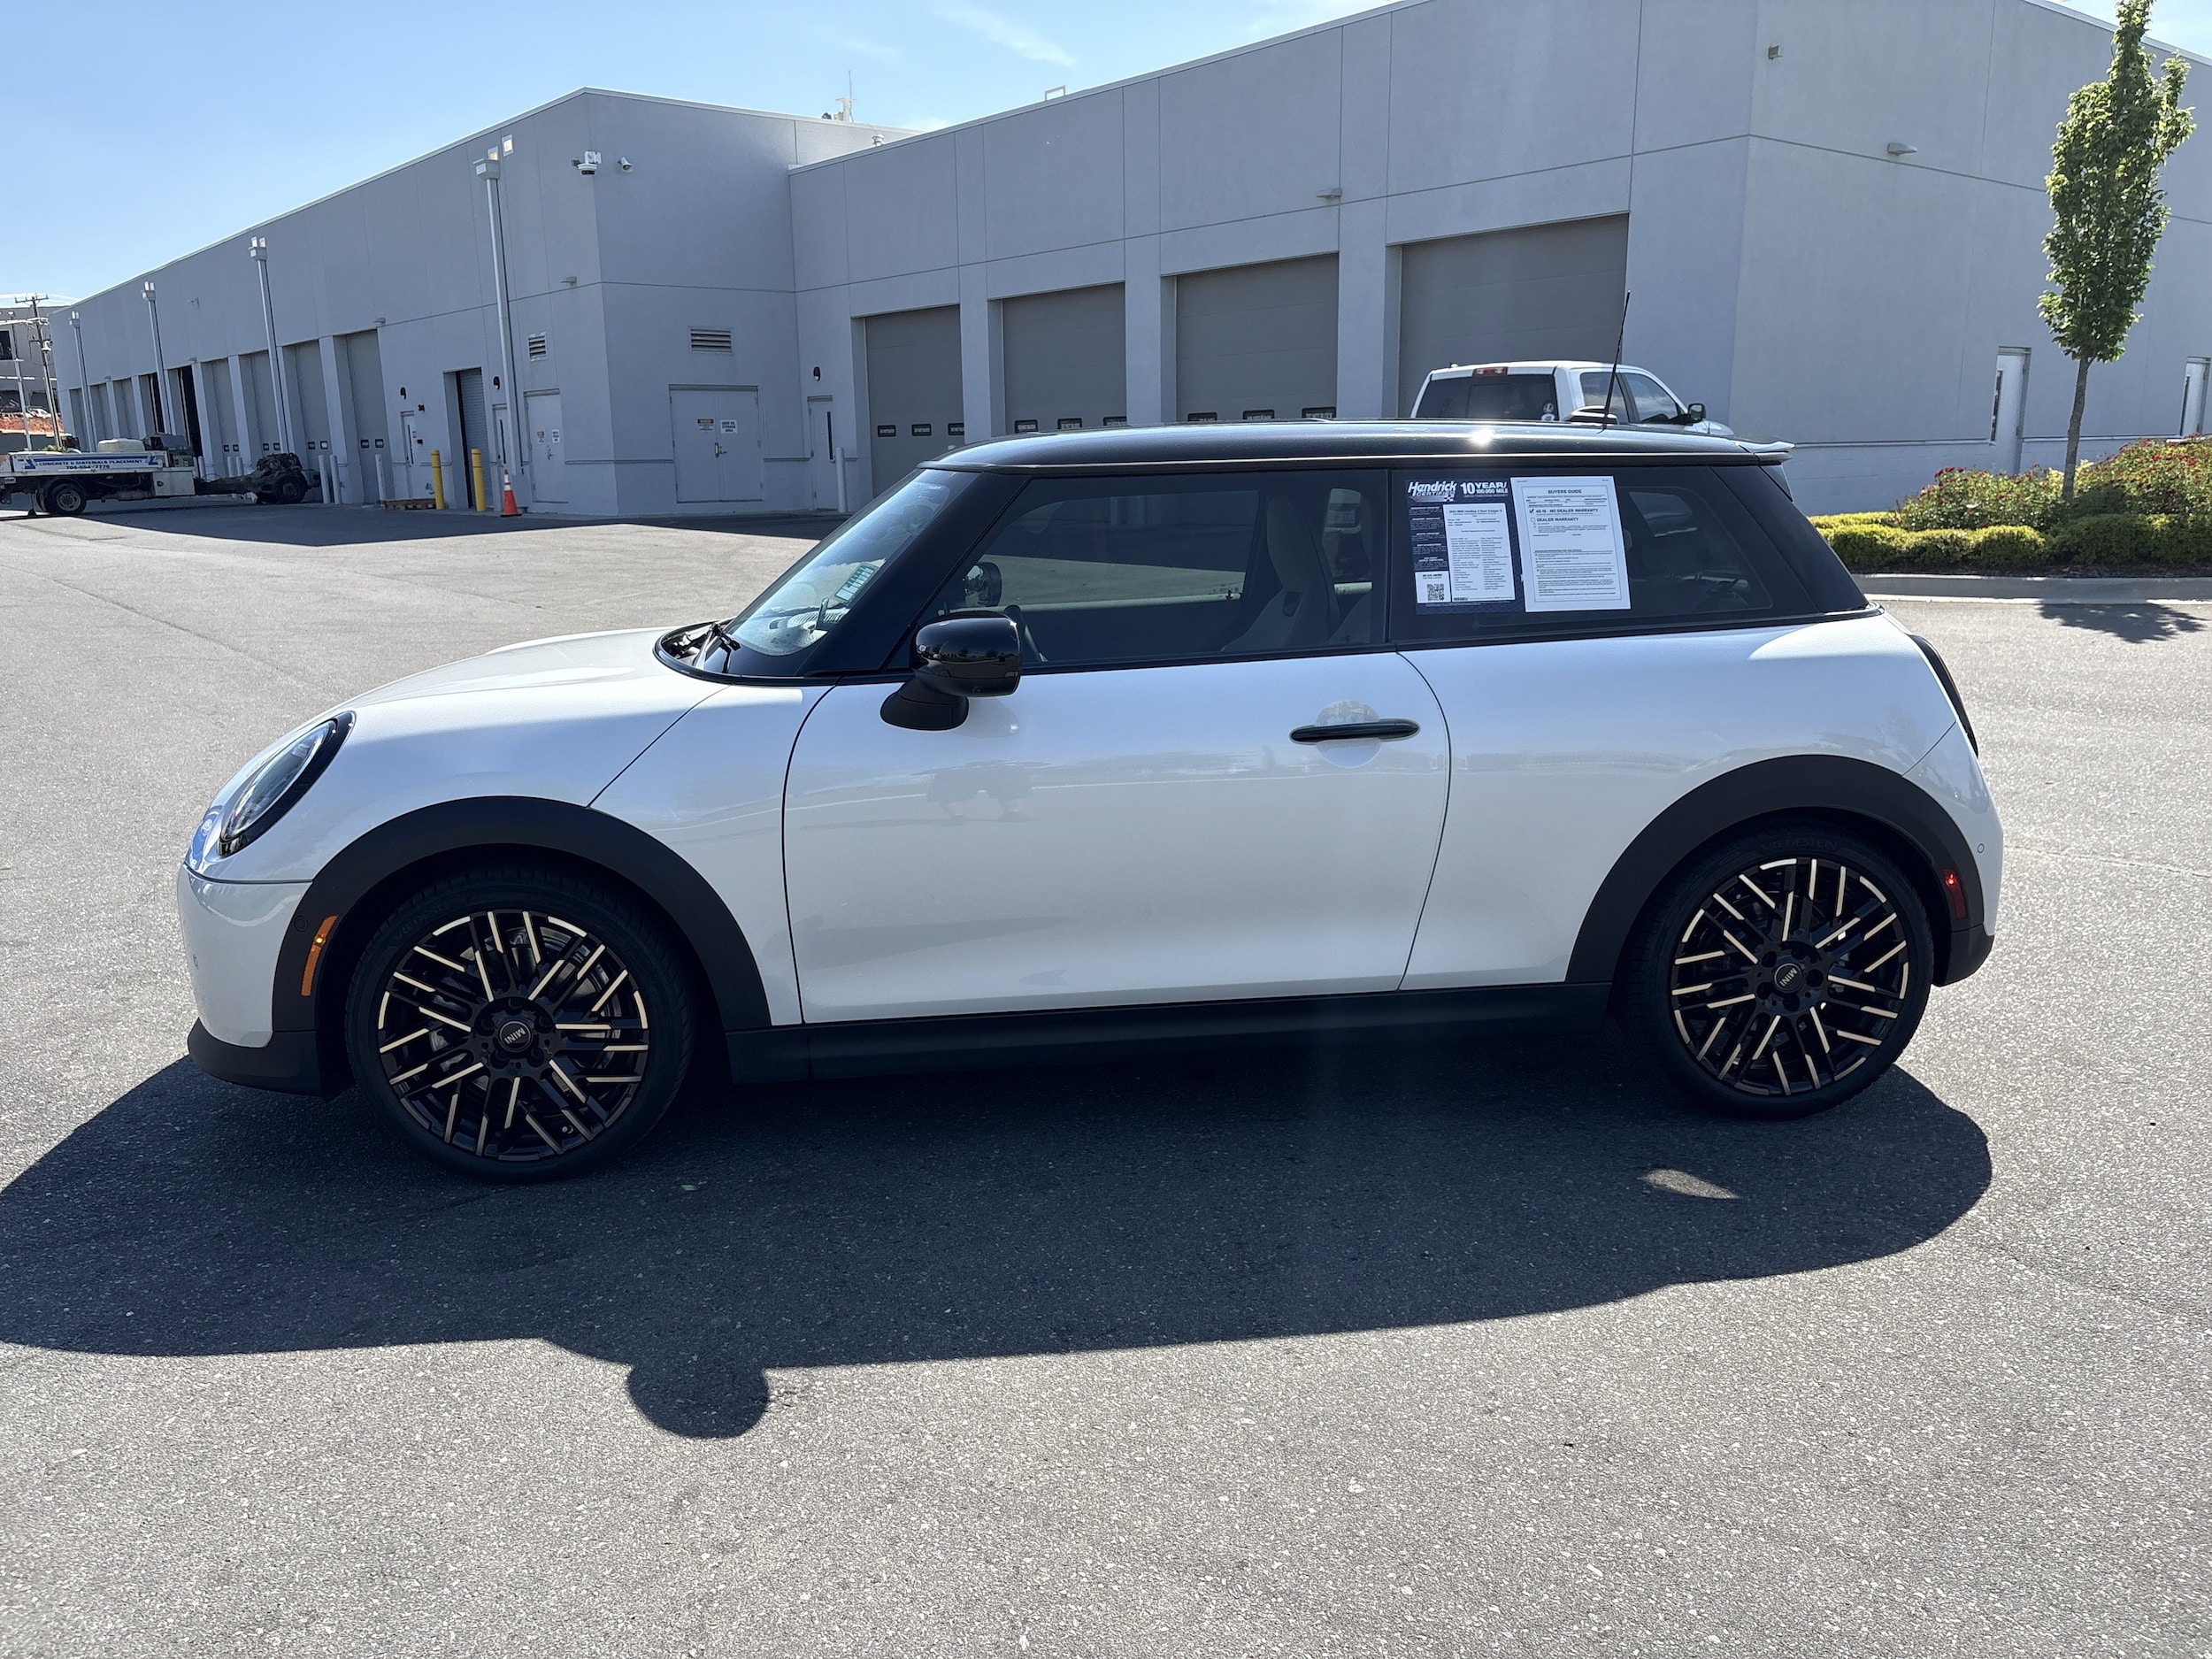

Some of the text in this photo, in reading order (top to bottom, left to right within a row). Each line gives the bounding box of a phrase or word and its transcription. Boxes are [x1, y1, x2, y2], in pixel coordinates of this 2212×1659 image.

[1407, 480, 1457, 496] Hendrick
[1460, 482, 1475, 495] 10
[1760, 838, 1838, 851] VREDESTEIN
[1779, 967, 1798, 987] MINI
[504, 1027, 526, 1044] MINI
